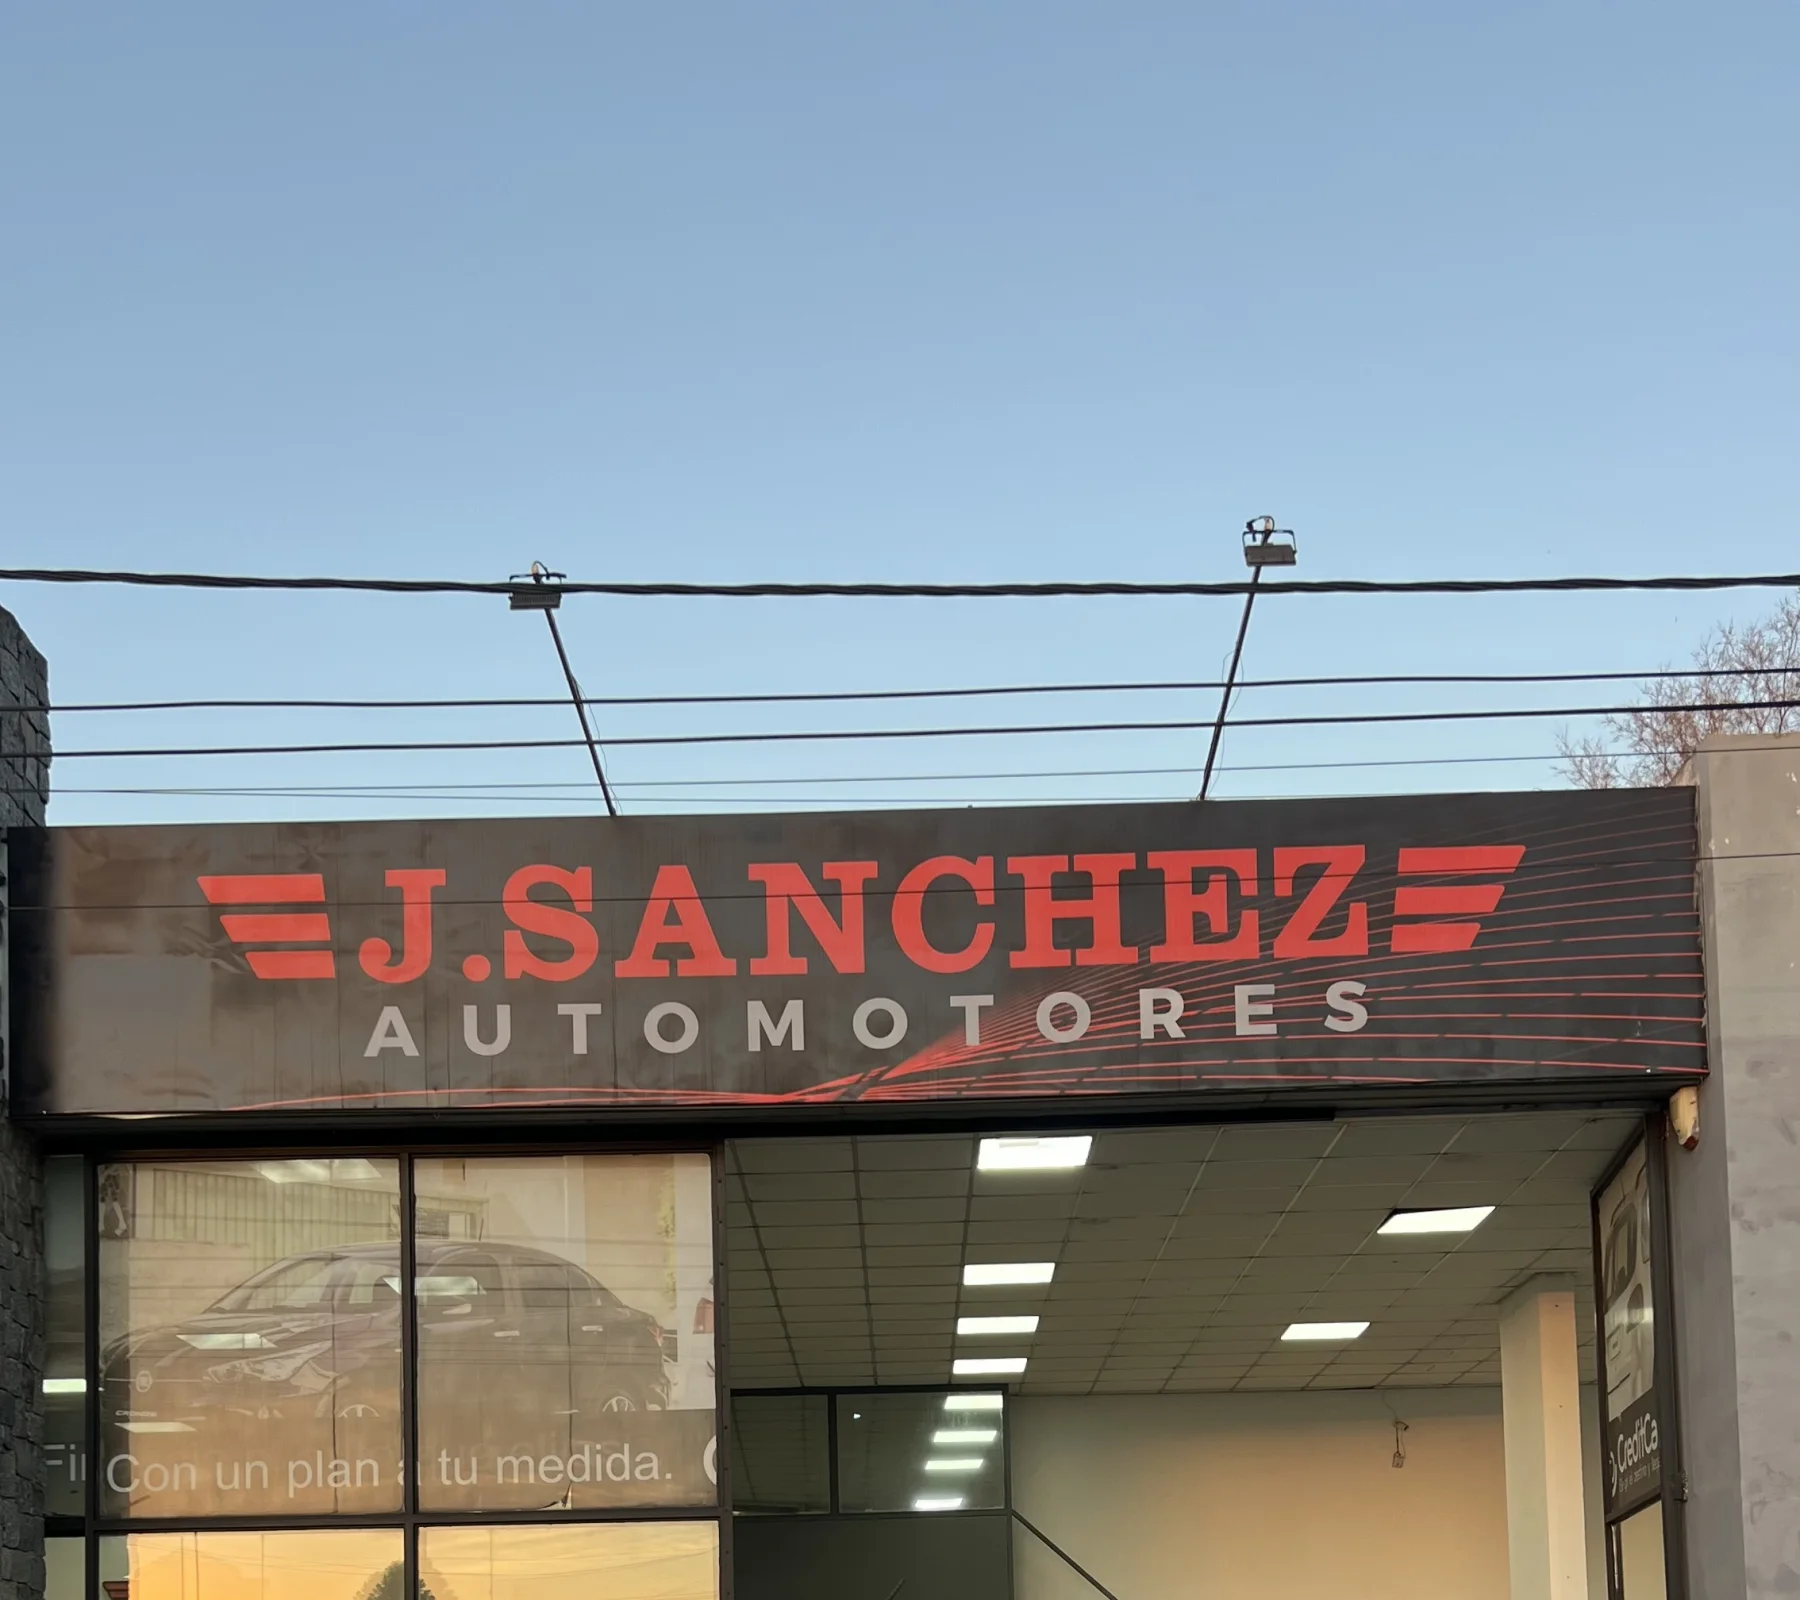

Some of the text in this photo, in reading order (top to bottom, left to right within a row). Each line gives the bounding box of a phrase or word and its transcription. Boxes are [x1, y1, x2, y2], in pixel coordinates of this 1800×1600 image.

[358, 845, 1369, 984] J.SANCHEZ
[364, 980, 1369, 1058] AUTOMOTORES
[106, 1454, 197, 1492] Con
[216, 1458, 269, 1490] un
[288, 1450, 379, 1498] plan
[437, 1448, 478, 1486] tu
[496, 1443, 672, 1484] medida.
